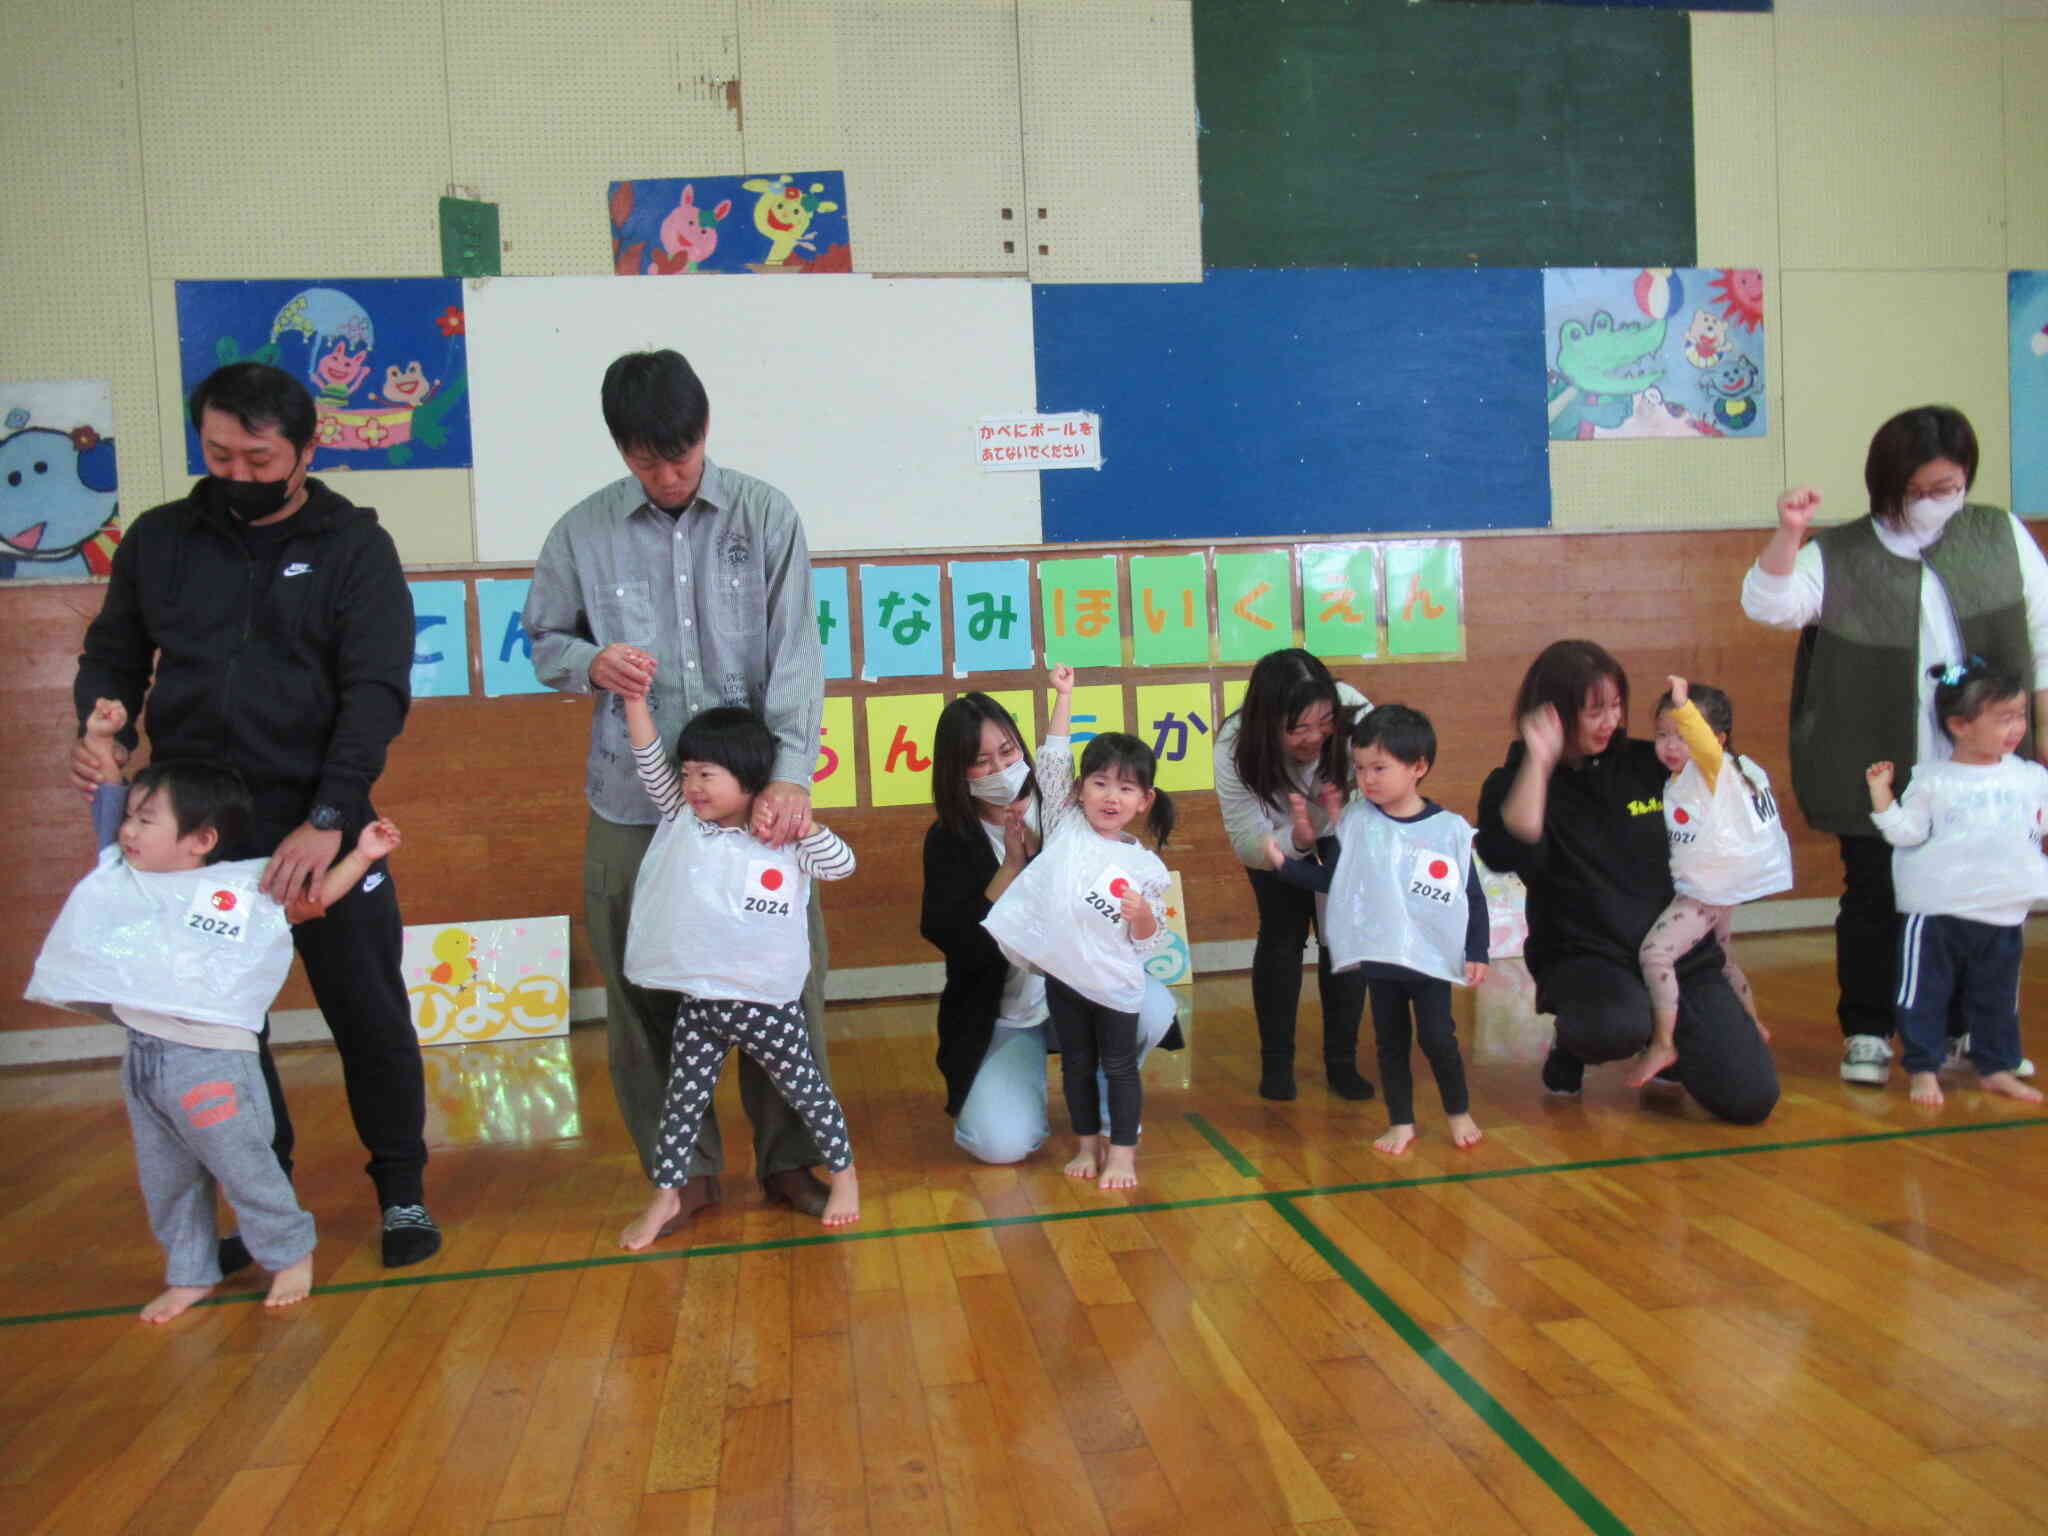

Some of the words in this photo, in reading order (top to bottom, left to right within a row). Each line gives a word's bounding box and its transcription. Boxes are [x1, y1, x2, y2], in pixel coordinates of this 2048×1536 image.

[980, 422, 1093, 440] かべにボールを
[982, 444, 1085, 461] あてないでください
[1411, 881, 1451, 904] 2024
[744, 897, 790, 916] 2024
[1085, 891, 1121, 924] 2024
[189, 914, 241, 938] 2024
[408, 981, 562, 1036] ひよこ
